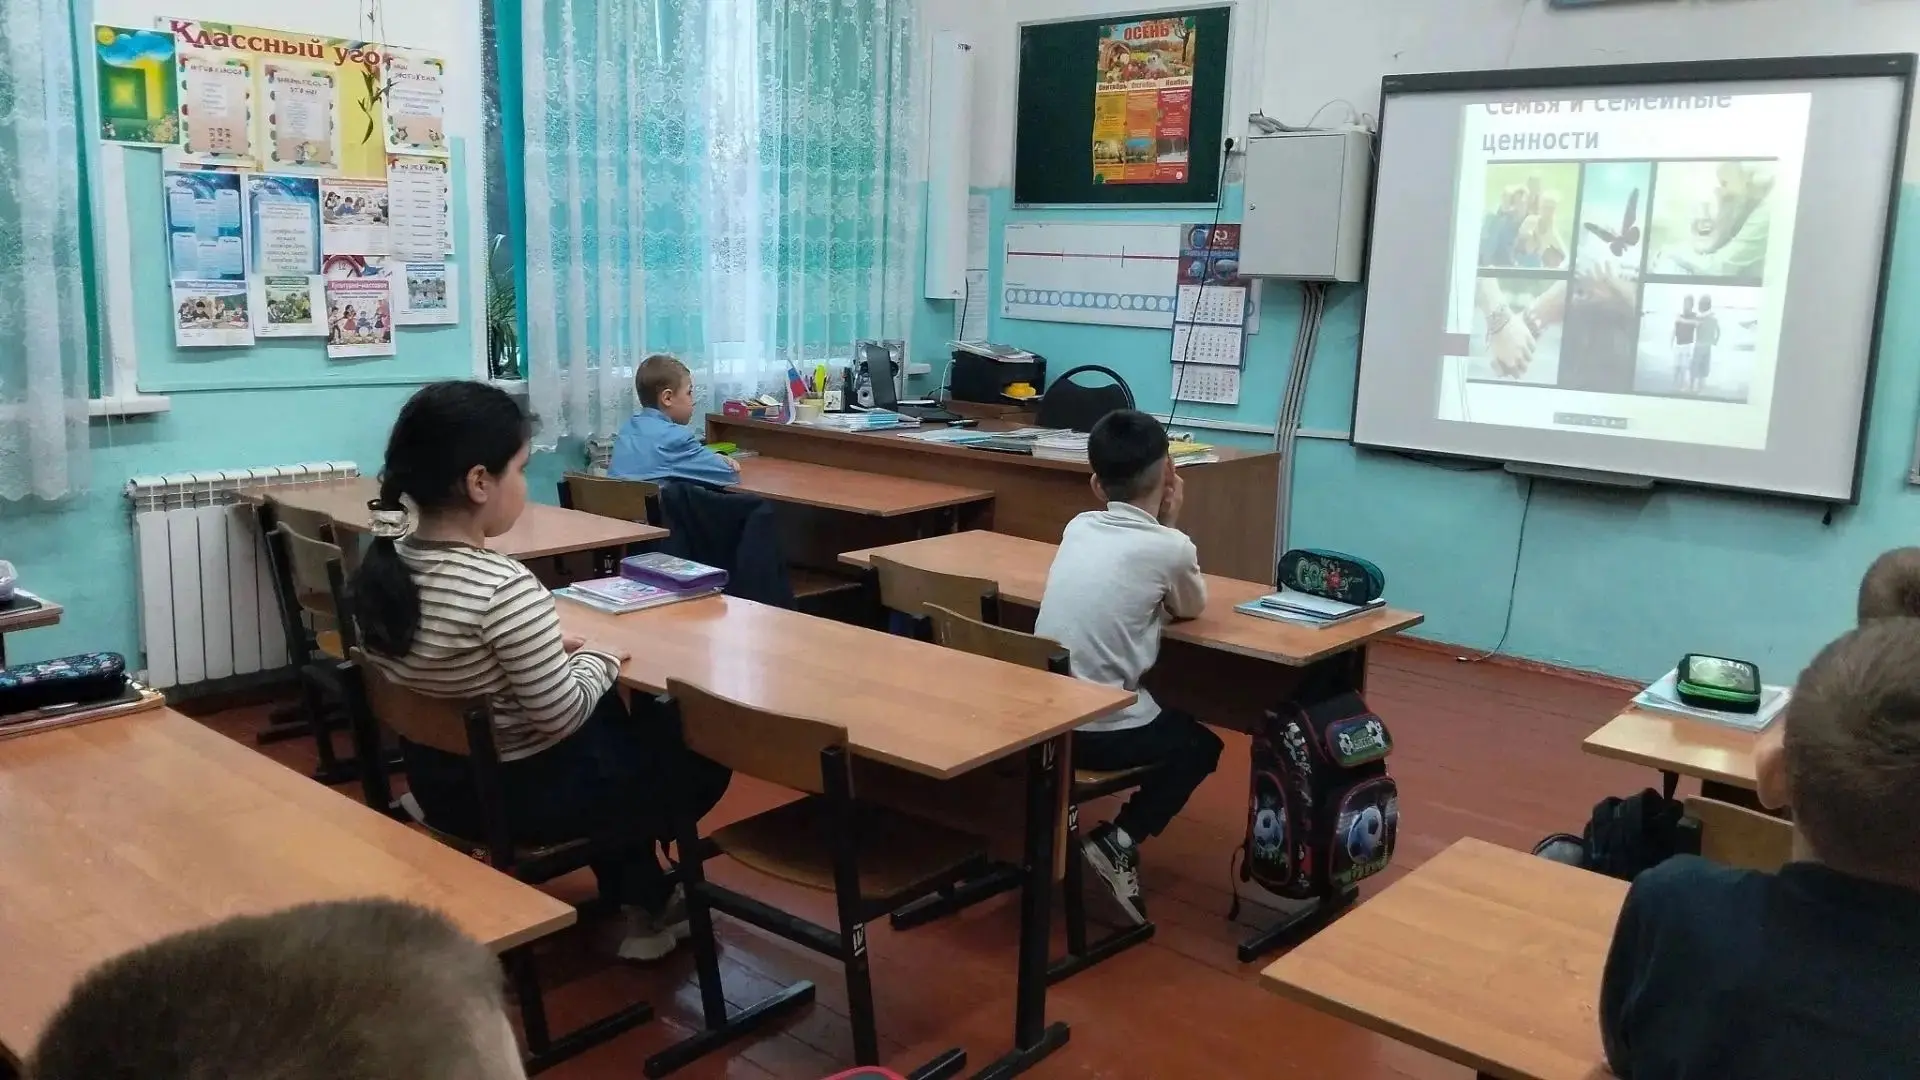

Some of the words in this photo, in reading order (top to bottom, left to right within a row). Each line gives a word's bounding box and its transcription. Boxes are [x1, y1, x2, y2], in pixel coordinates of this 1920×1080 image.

[169, 20, 324, 58] Классный
[333, 46, 380, 66] уго
[1123, 23, 1170, 40] ОСЕНЬ
[1482, 131, 1599, 154] ценности
